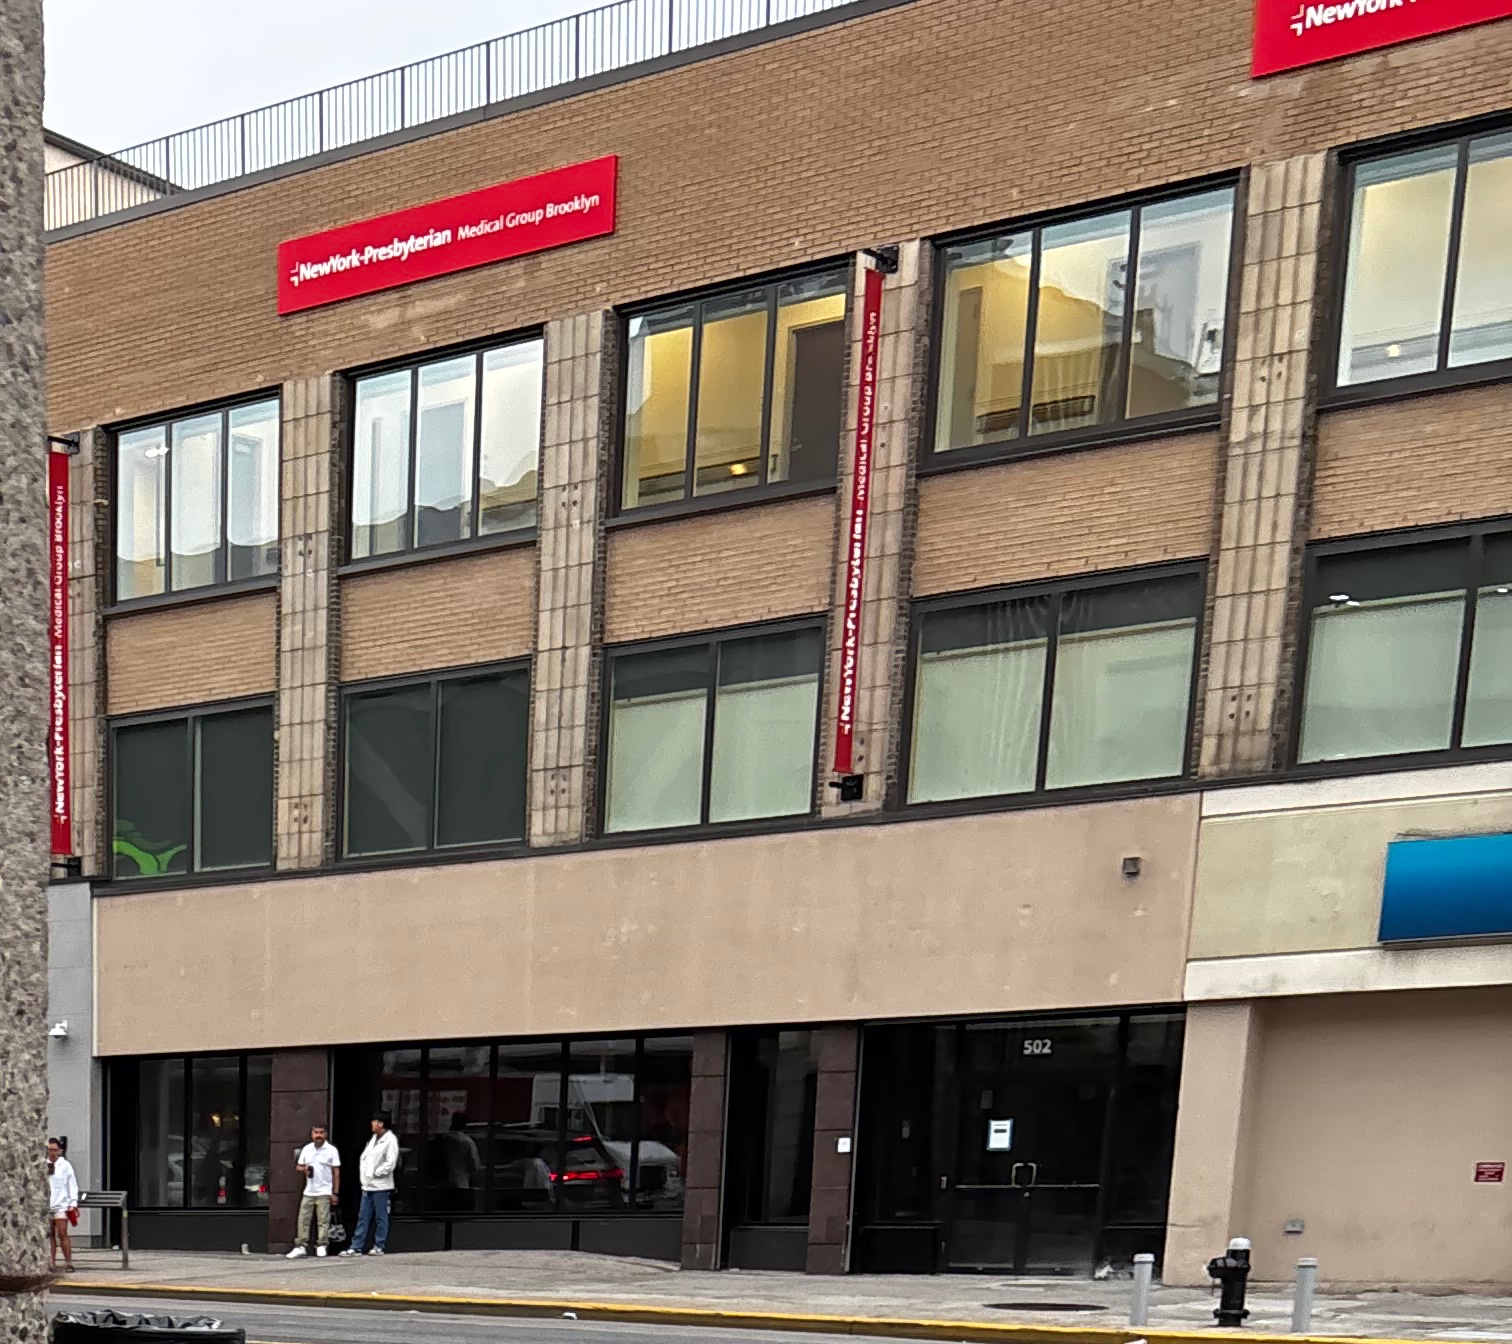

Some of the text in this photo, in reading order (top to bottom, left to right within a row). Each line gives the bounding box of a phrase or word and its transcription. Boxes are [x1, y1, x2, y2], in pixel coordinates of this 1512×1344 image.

[299, 193, 599, 281] NewYork-Presbyterian Medical Group Brooklyn
[1023, 1038, 1052, 1055] 502
